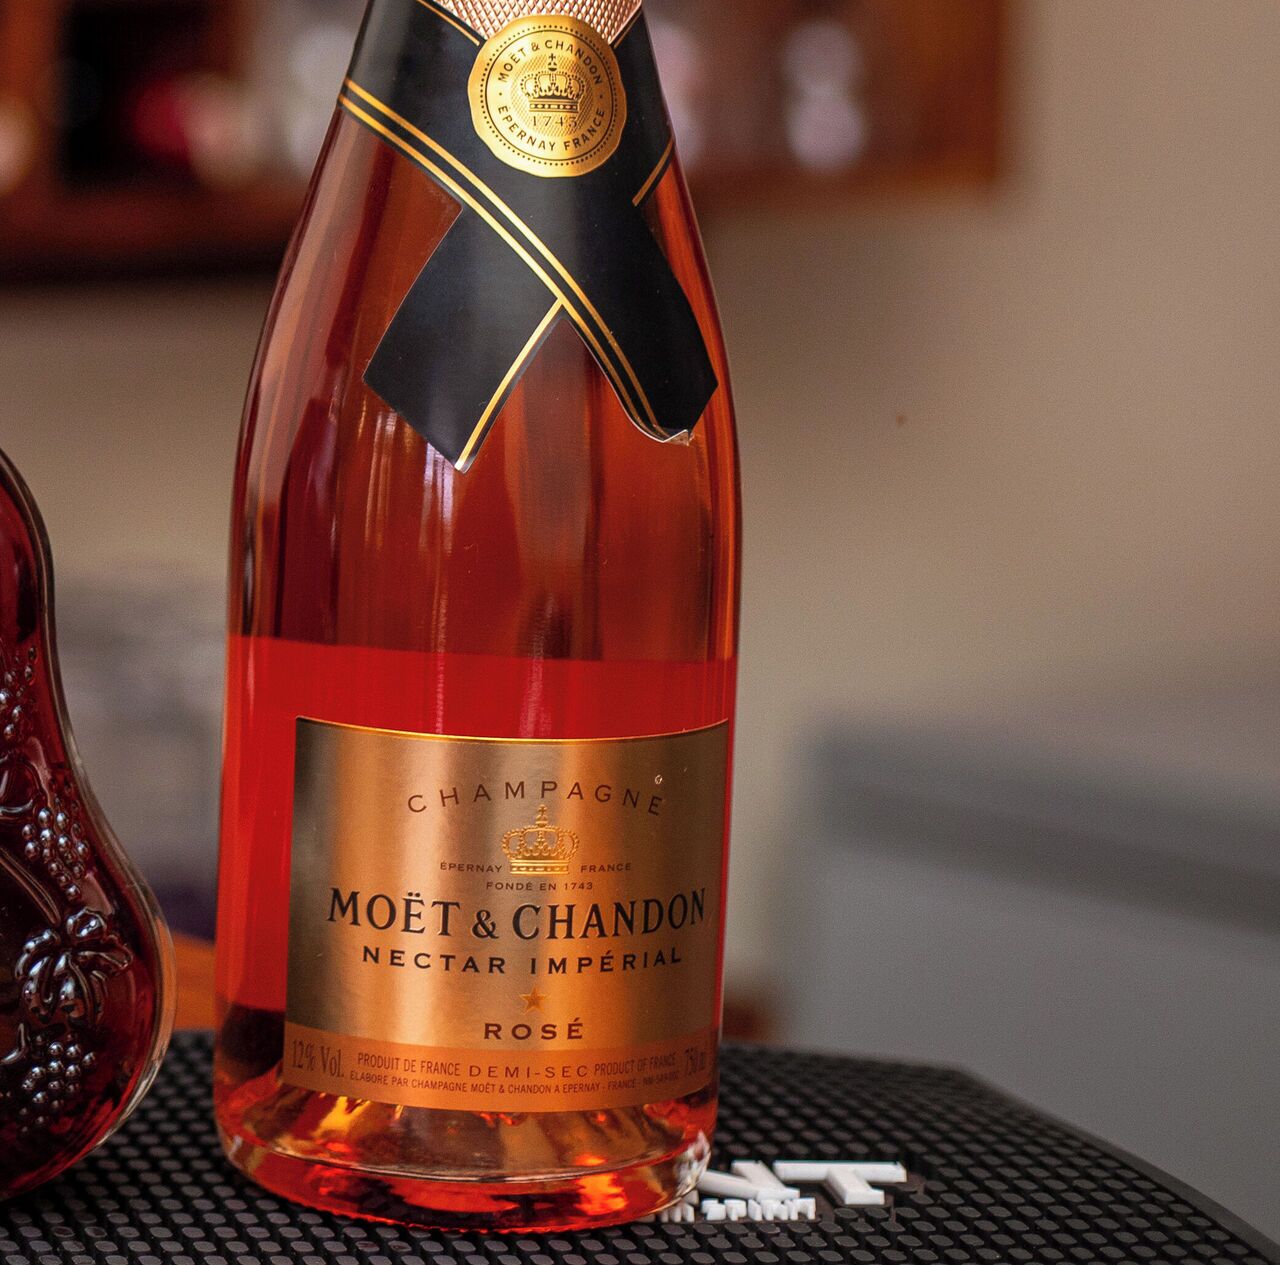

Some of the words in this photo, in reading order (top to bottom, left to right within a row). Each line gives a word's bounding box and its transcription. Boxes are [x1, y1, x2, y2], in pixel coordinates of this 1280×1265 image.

[531, 42, 540, 51] &
[544, 39, 603, 85] CHANDON
[532, 115, 578, 128] 1743
[564, 109, 605, 151] FRANCE
[406, 779, 664, 817] CHAMPAGNE
[439, 862, 503, 873] ÉPERNAY
[580, 862, 632, 873] FRANCE
[486, 881, 533, 891] FONDÉ
[539, 882, 557, 891] EN
[564, 881, 594, 891] 1743
[327, 886, 462, 936] MOËT
[470, 908, 500, 939] &
[512, 886, 707, 940] CHANDON
[362, 945, 507, 975] NECTAR
[530, 946, 683, 975] IMPÉRIAL
[483, 1016, 585, 1040] ROSÉ
[357, 1052, 400, 1073] PRODUIT
[403, 1058, 417, 1073] DE
[420, 1059, 461, 1077] FRANCE
[469, 1064, 589, 1079] DEMI-SEC
[594, 1060, 635, 1077] PRODUCT
[391, 1076, 409, 1087] PAR
[412, 1079, 468, 1093] CHAMPAGNE
[498, 1085, 505, 1093] &
[507, 1084, 552, 1094] CHANDON
